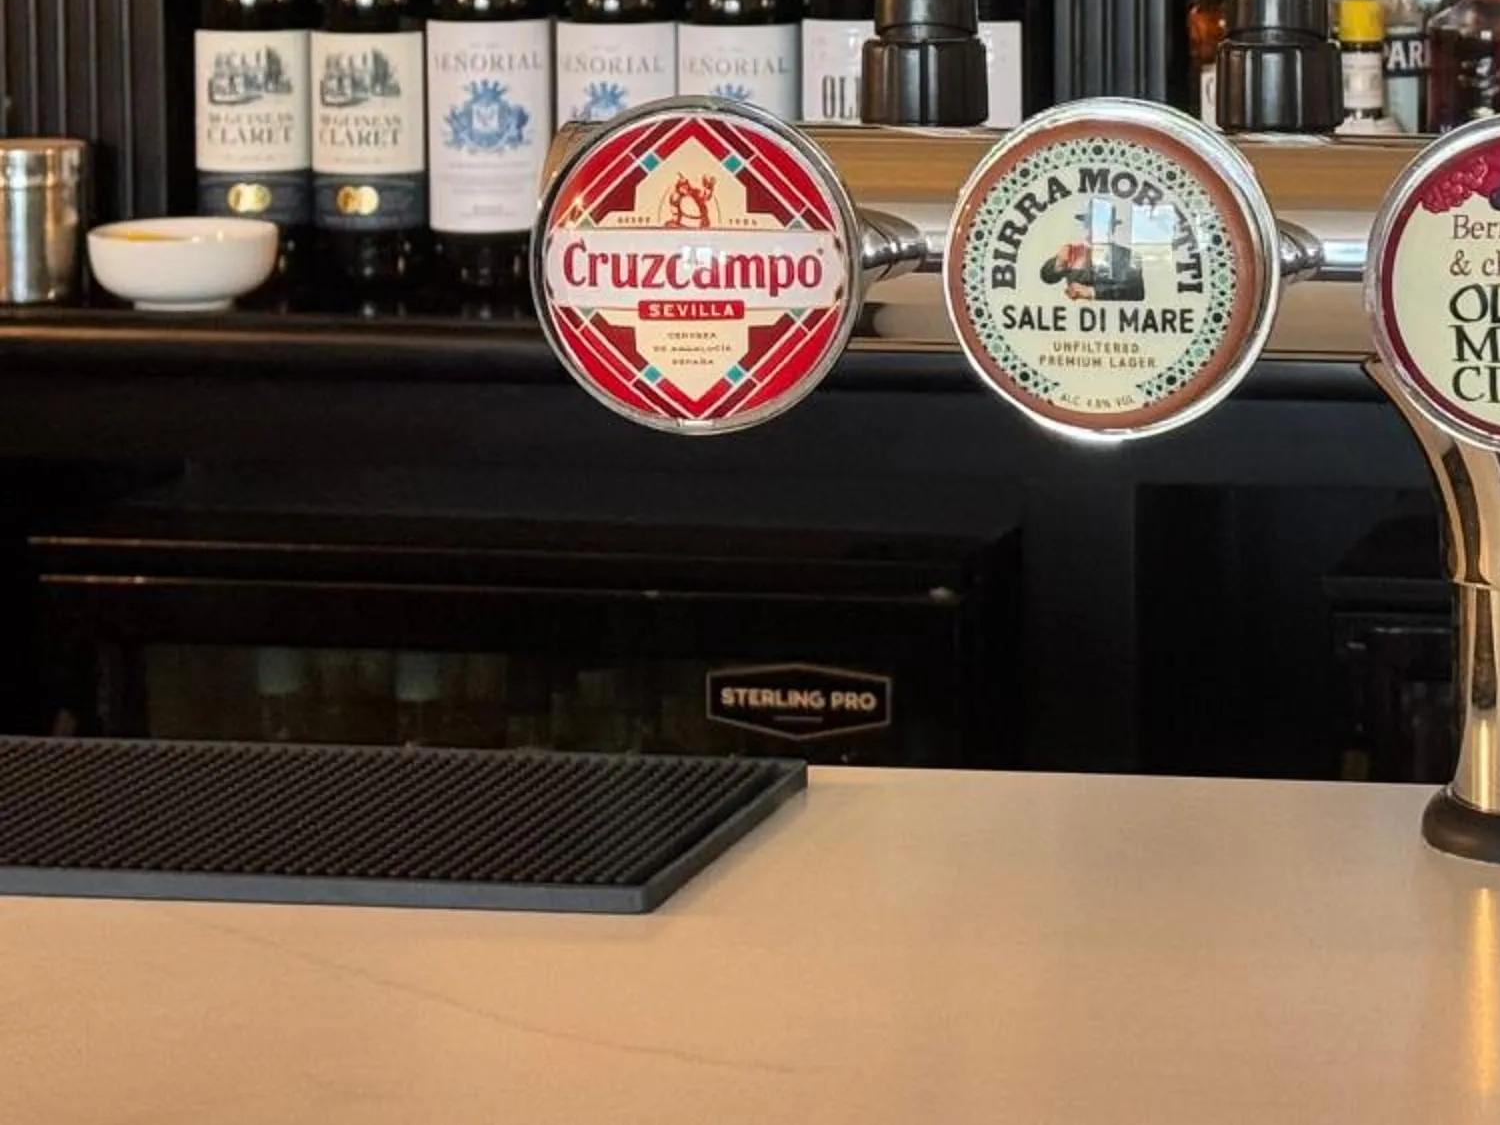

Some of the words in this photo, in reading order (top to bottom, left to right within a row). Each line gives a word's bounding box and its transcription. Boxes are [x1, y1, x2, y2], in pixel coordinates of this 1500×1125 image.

[991, 175, 1073, 290] BIRRA
[562, 238, 825, 298] Cruzcampo
[1450, 249, 1473, 277] &
[648, 302, 736, 318] SEVILLA
[1002, 305, 1067, 332] SALE
[1079, 307, 1106, 333] DI
[1119, 308, 1194, 334] MARE
[1039, 355, 1102, 368] PREMIUM
[1109, 356, 1156, 368] LAGER
[1053, 342, 1140, 354] UNFILTERED
[720, 686, 826, 710] STERLING
[830, 690, 878, 712] PRO
